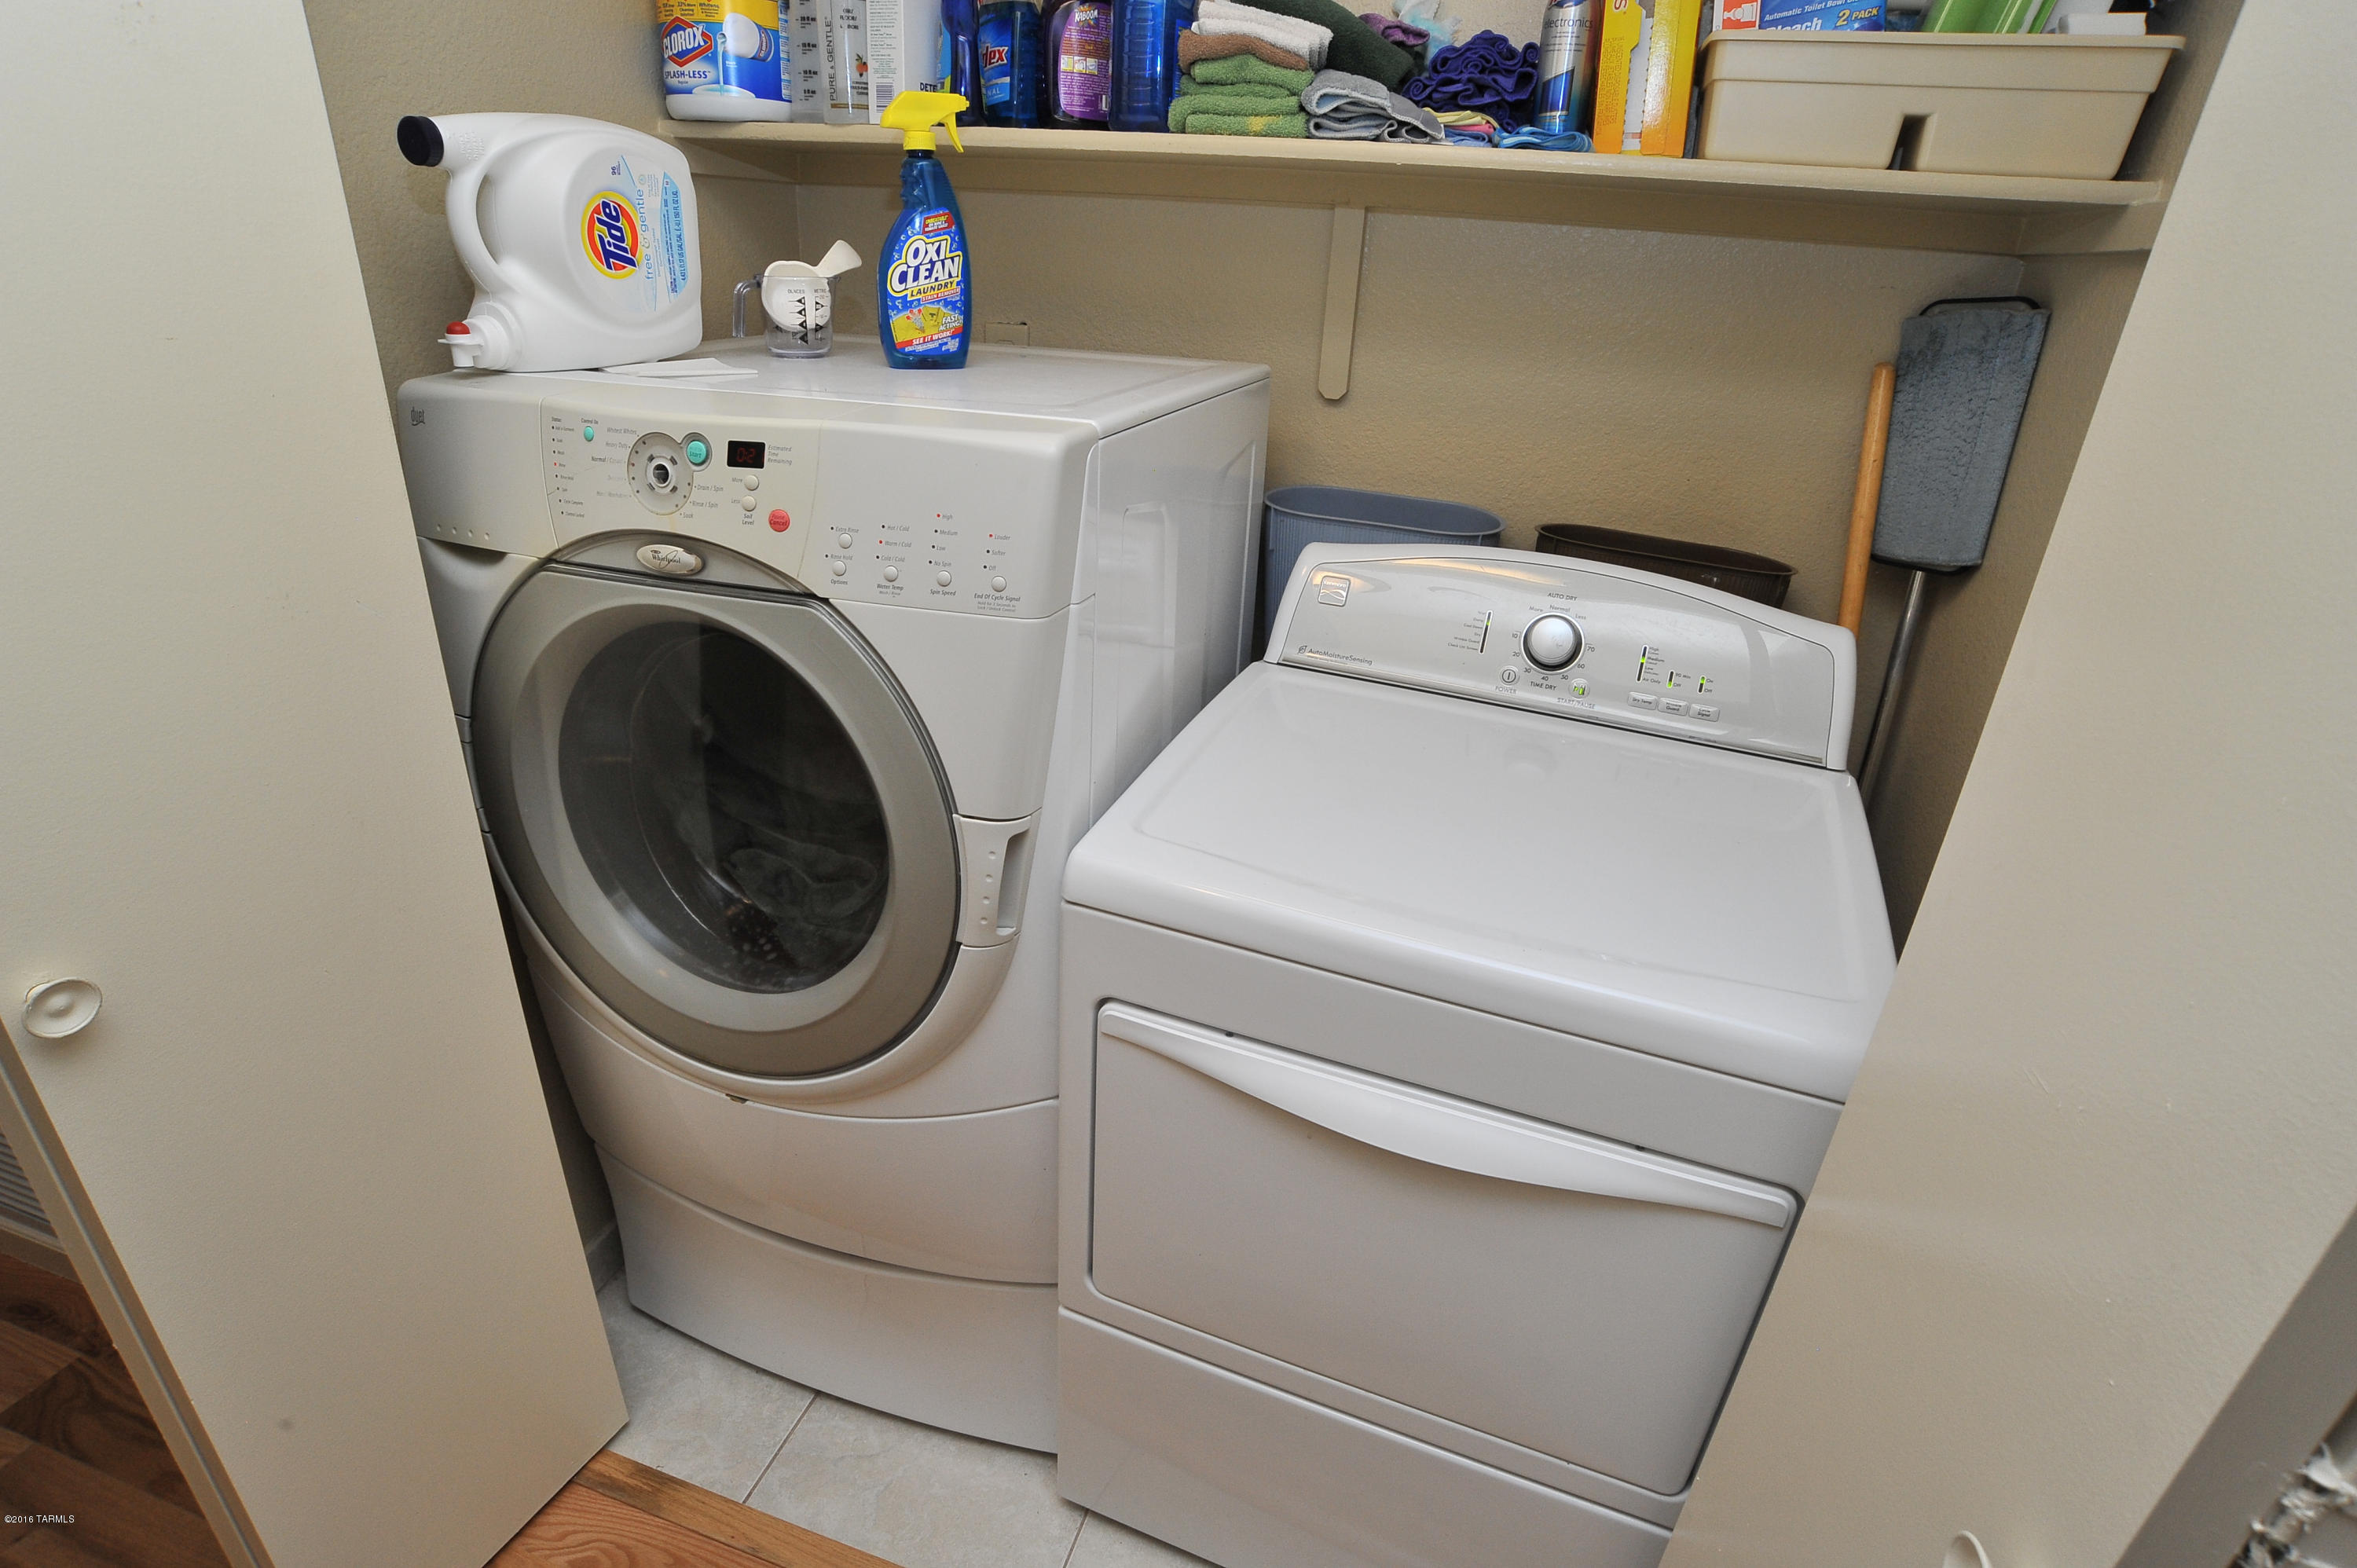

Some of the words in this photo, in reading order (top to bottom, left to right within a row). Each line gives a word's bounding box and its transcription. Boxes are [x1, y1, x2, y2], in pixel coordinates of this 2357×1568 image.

[1074, 8, 1098, 22] KABOOM
[1764, 7, 1802, 21] Automatic
[1804, 4, 1824, 13] Toilet
[1836, 9, 1851, 26] 2
[1851, 7, 1880, 20] PACK
[1544, 17, 1593, 29] electronics
[663, 25, 705, 59] CLOROX
[825, 20, 833, 62] GENTLE
[611, 166, 617, 176] 96
[636, 189, 649, 232] gentle
[595, 200, 638, 271] Tide
[906, 238, 948, 267] OXI
[645, 253, 654, 280] free
[891, 255, 960, 293] CLEAN
[910, 280, 955, 297] LAUNDRY
[938, 288, 959, 297] REMOVER
[943, 314, 959, 324] FAST
[912, 337, 924, 345] SEE
[652, 554, 681, 563] Whirlpool
[1308, 648, 1372, 666] AutoMoistureSensing
[1495, 686, 1517, 694] POWER
[1557, 697, 1595, 709] START/PAUSE
